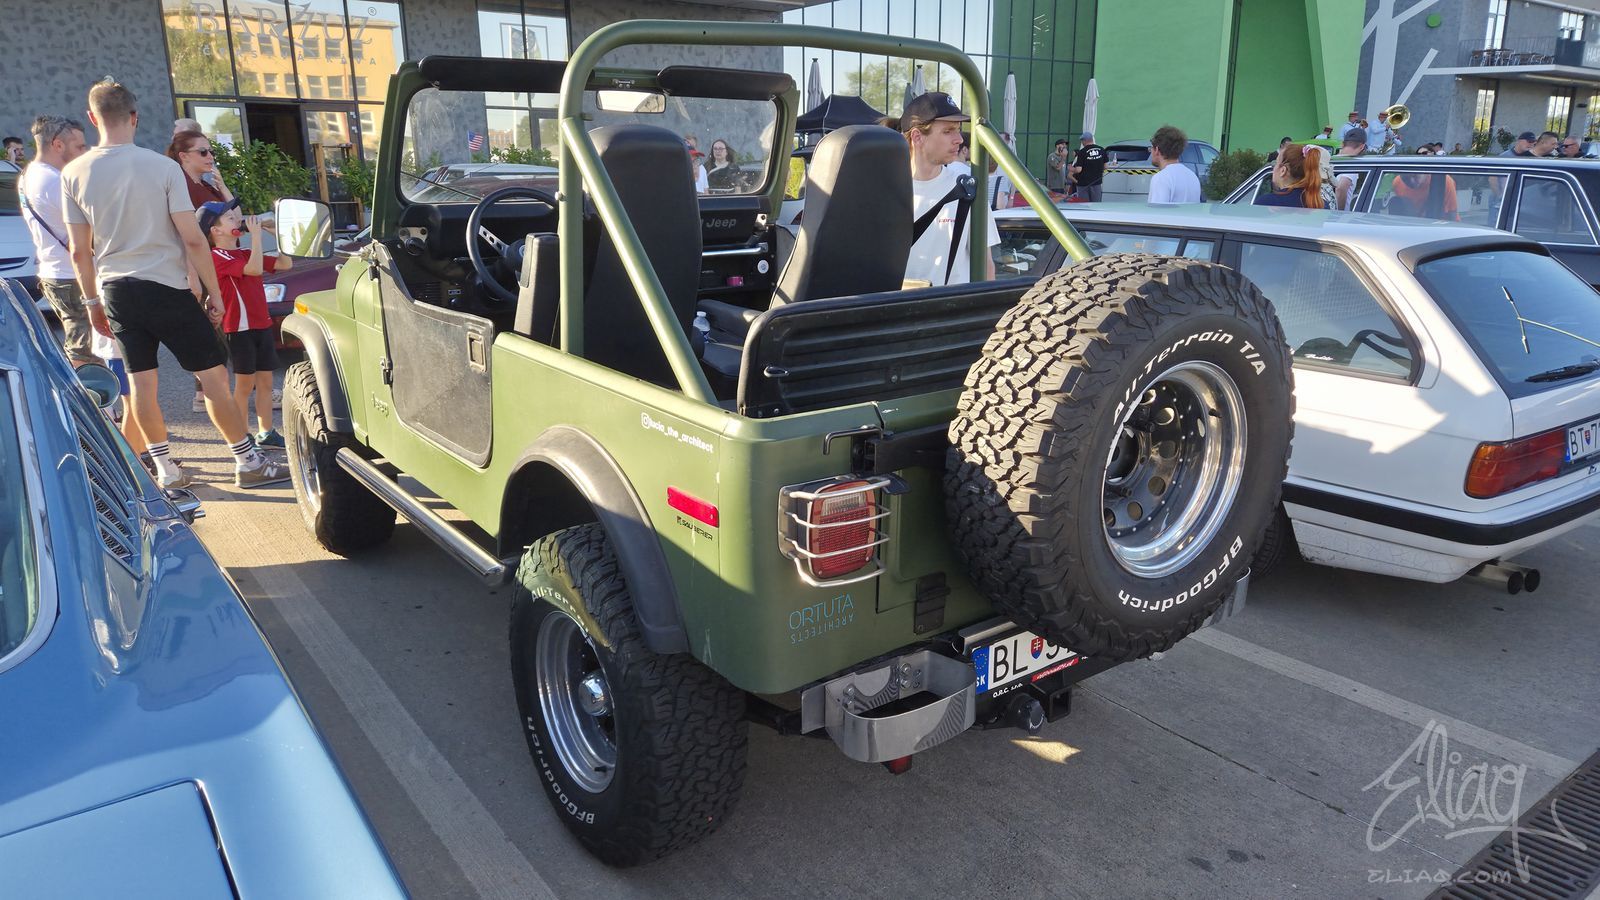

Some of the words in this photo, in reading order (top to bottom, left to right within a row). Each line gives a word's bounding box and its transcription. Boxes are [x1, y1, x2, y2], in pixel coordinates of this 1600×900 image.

[706, 219, 737, 229] Jeep
[1113, 329, 1234, 426] All-Terrain
[1239, 340, 1267, 376] T/A
[1569, 427, 1585, 456] BT
[1118, 535, 1244, 613] BFGoodrich
[789, 593, 854, 630] ORTUTA
[791, 612, 854, 645] ARCHITECTS
[992, 639, 1029, 684] BL
[527, 716, 596, 825] BFGoodrich
